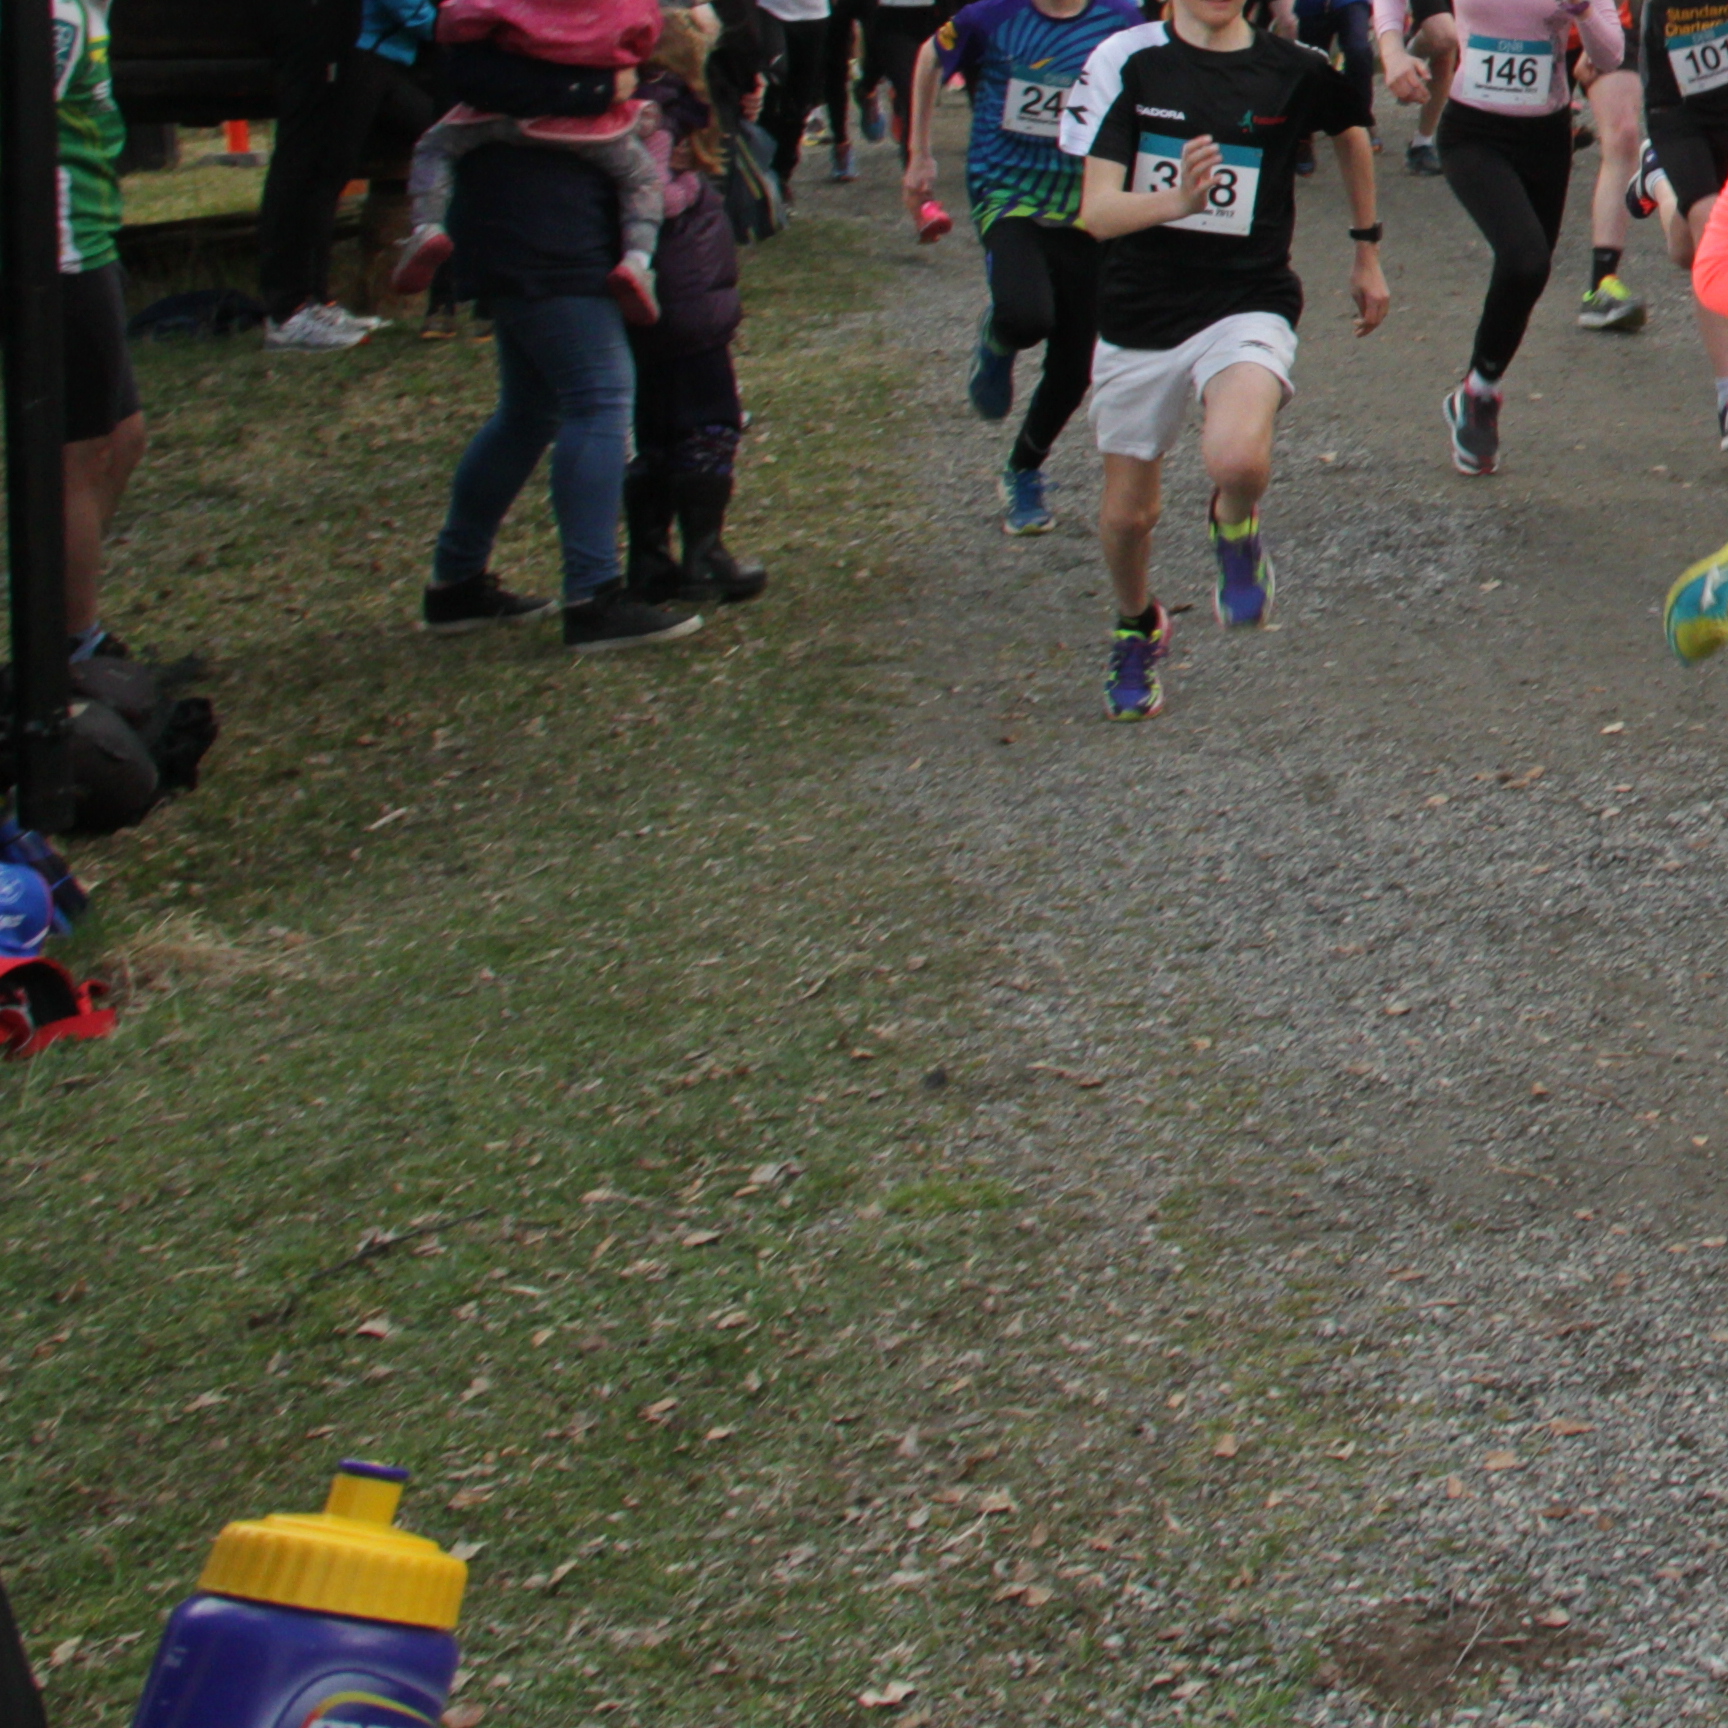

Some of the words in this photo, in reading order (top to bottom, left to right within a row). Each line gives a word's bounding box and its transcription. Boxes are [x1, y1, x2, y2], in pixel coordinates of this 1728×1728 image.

[1482, 55, 1538, 87] 146
[1020, 86, 1064, 118] 24
[1151, 161, 1237, 207] 38
